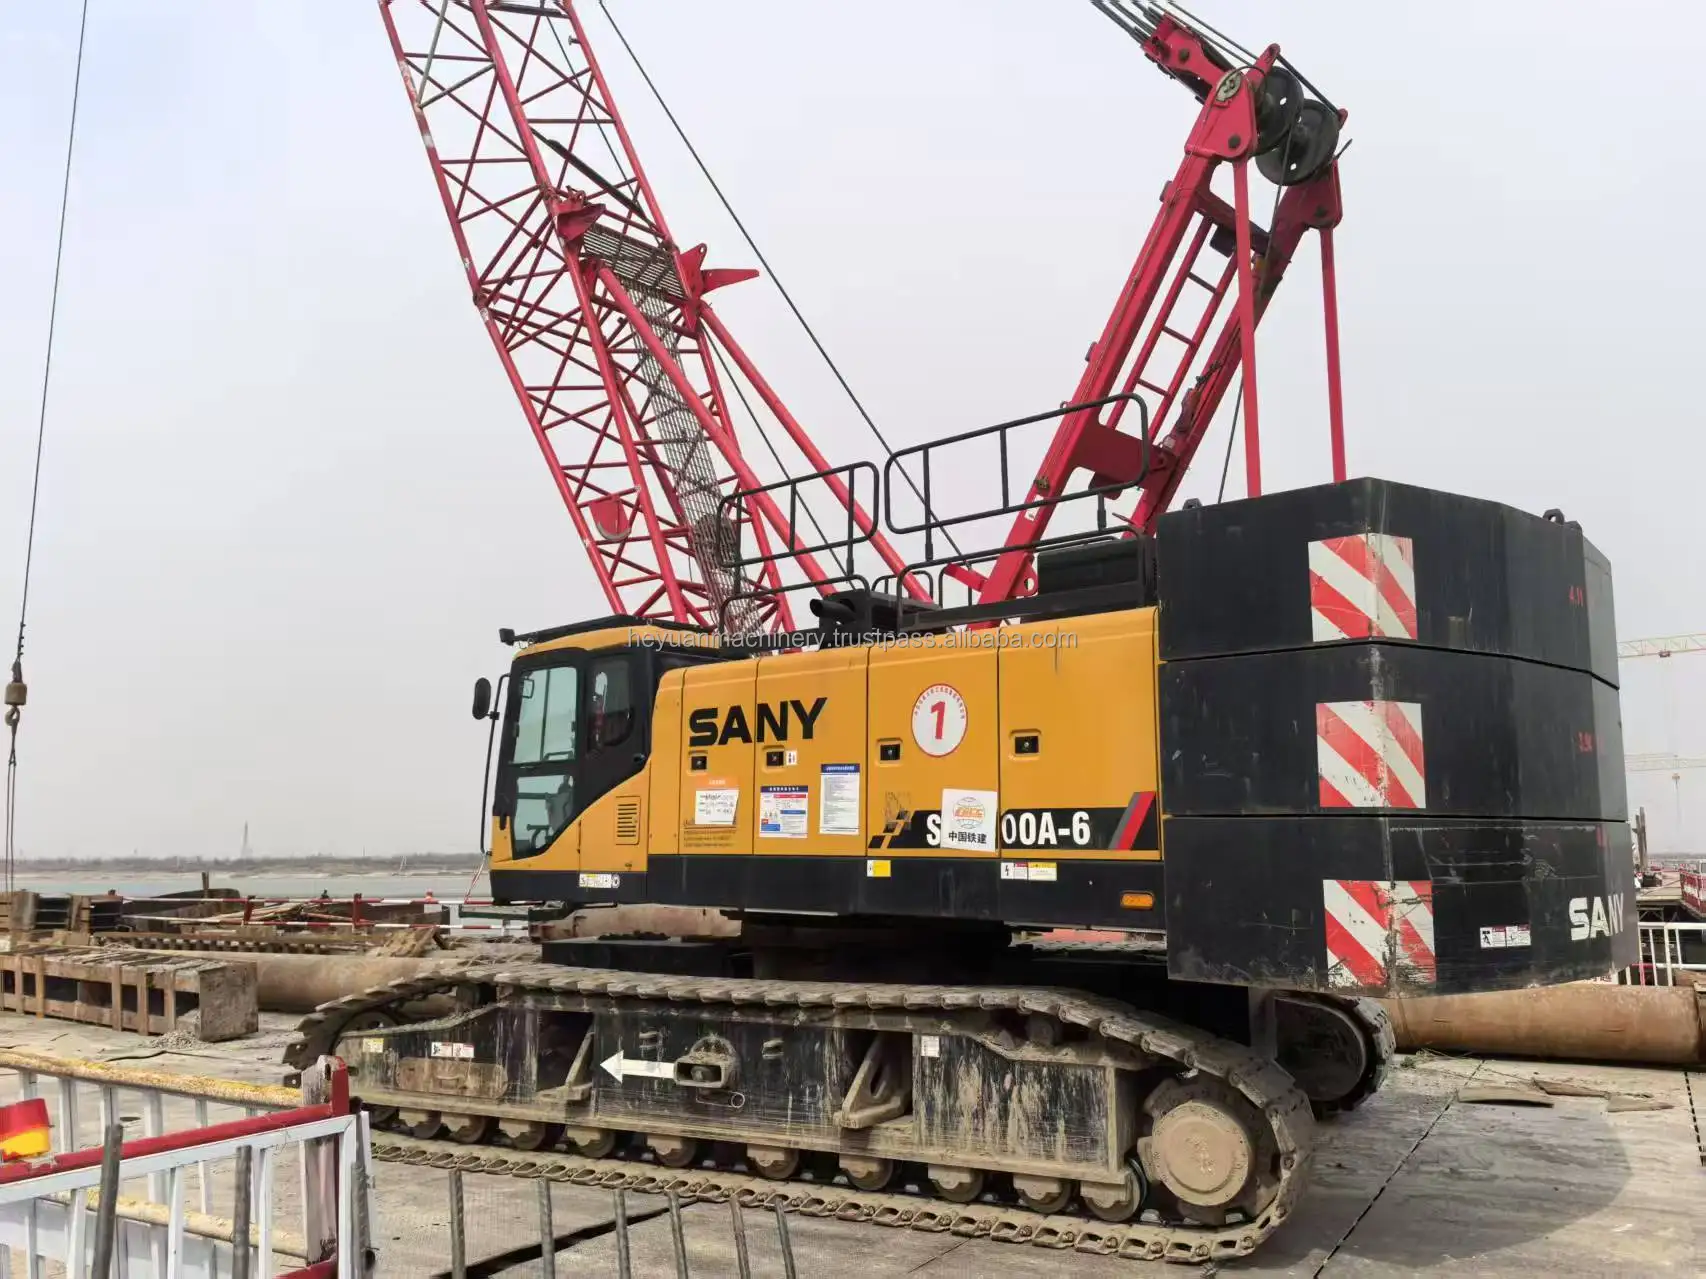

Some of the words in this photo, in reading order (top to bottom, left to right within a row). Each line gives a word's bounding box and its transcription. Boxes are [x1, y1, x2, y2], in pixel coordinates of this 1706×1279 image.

[689, 697, 828, 747] SANY
[930, 700, 946, 740] 1
[948, 831, 987, 844] 中国铁建
[1568, 892, 1624, 941] SANY
